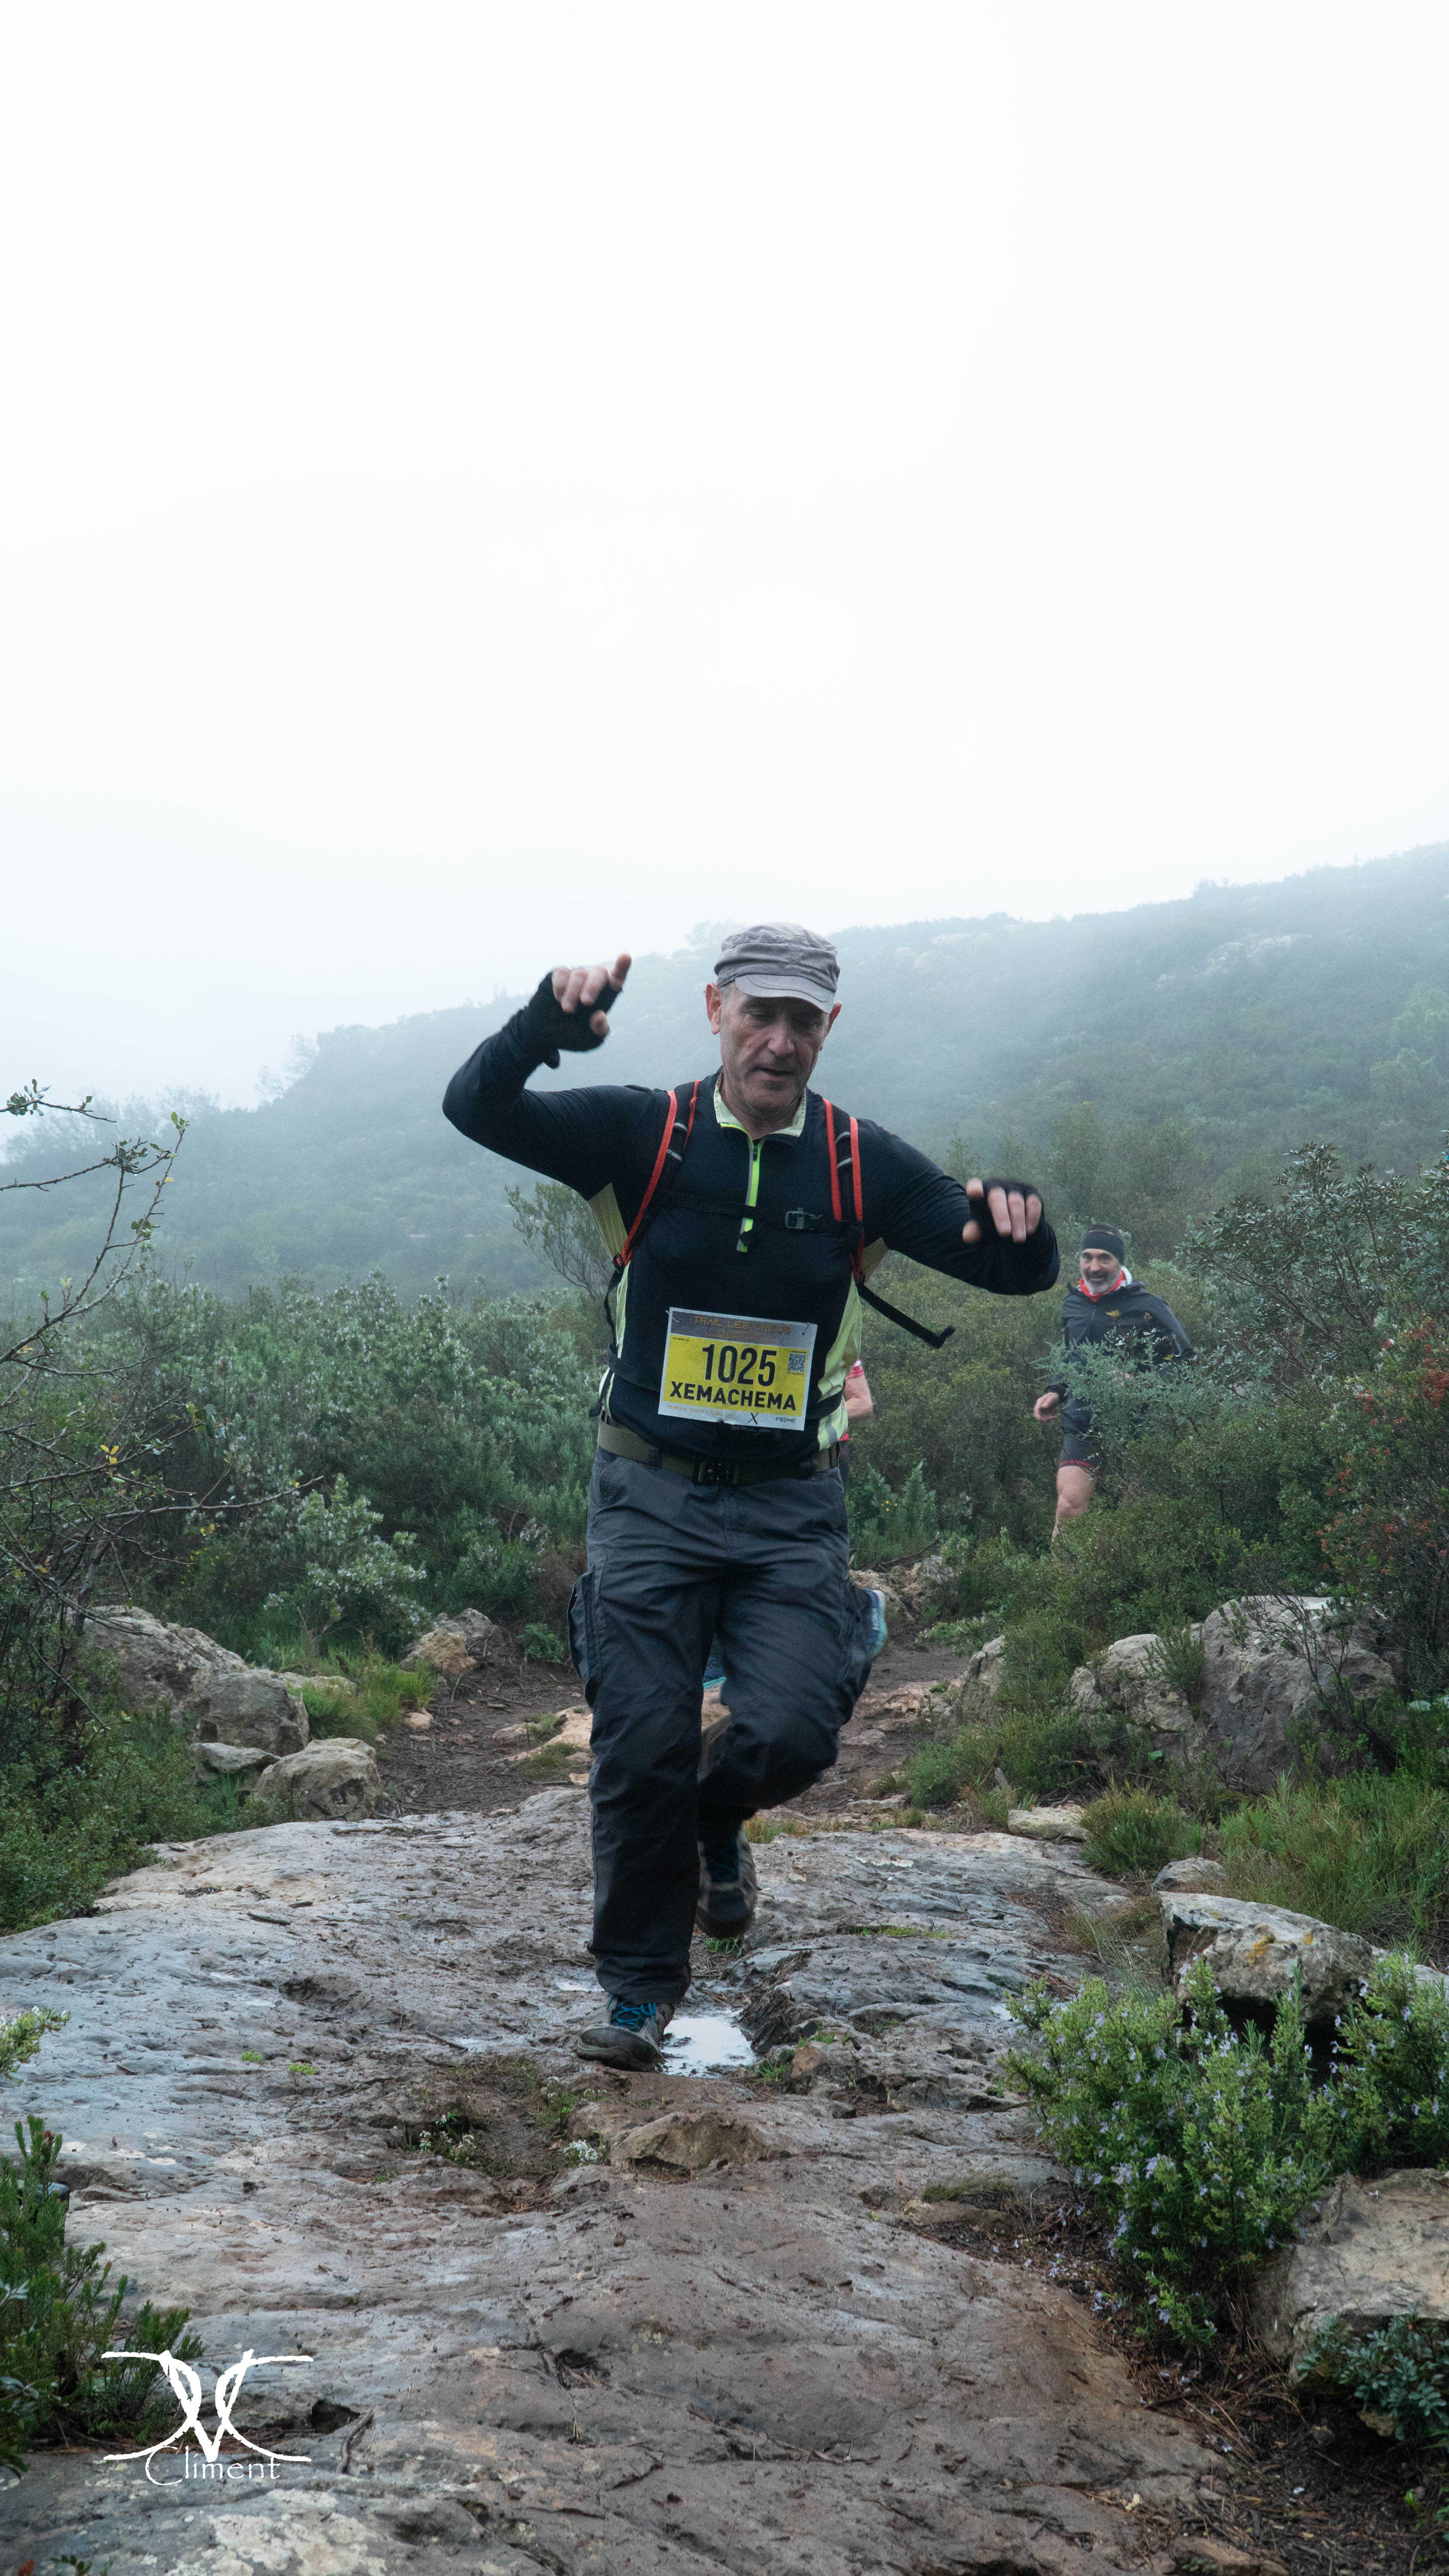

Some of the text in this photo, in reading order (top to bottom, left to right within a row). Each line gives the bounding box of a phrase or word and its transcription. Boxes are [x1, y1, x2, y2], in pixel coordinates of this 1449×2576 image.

[694, 1316, 722, 1327] TRAIL
[728, 1320, 749, 1329] LES
[702, 1344, 777, 1387] 1025
[670, 1381, 796, 1411] XEMACHEMA
